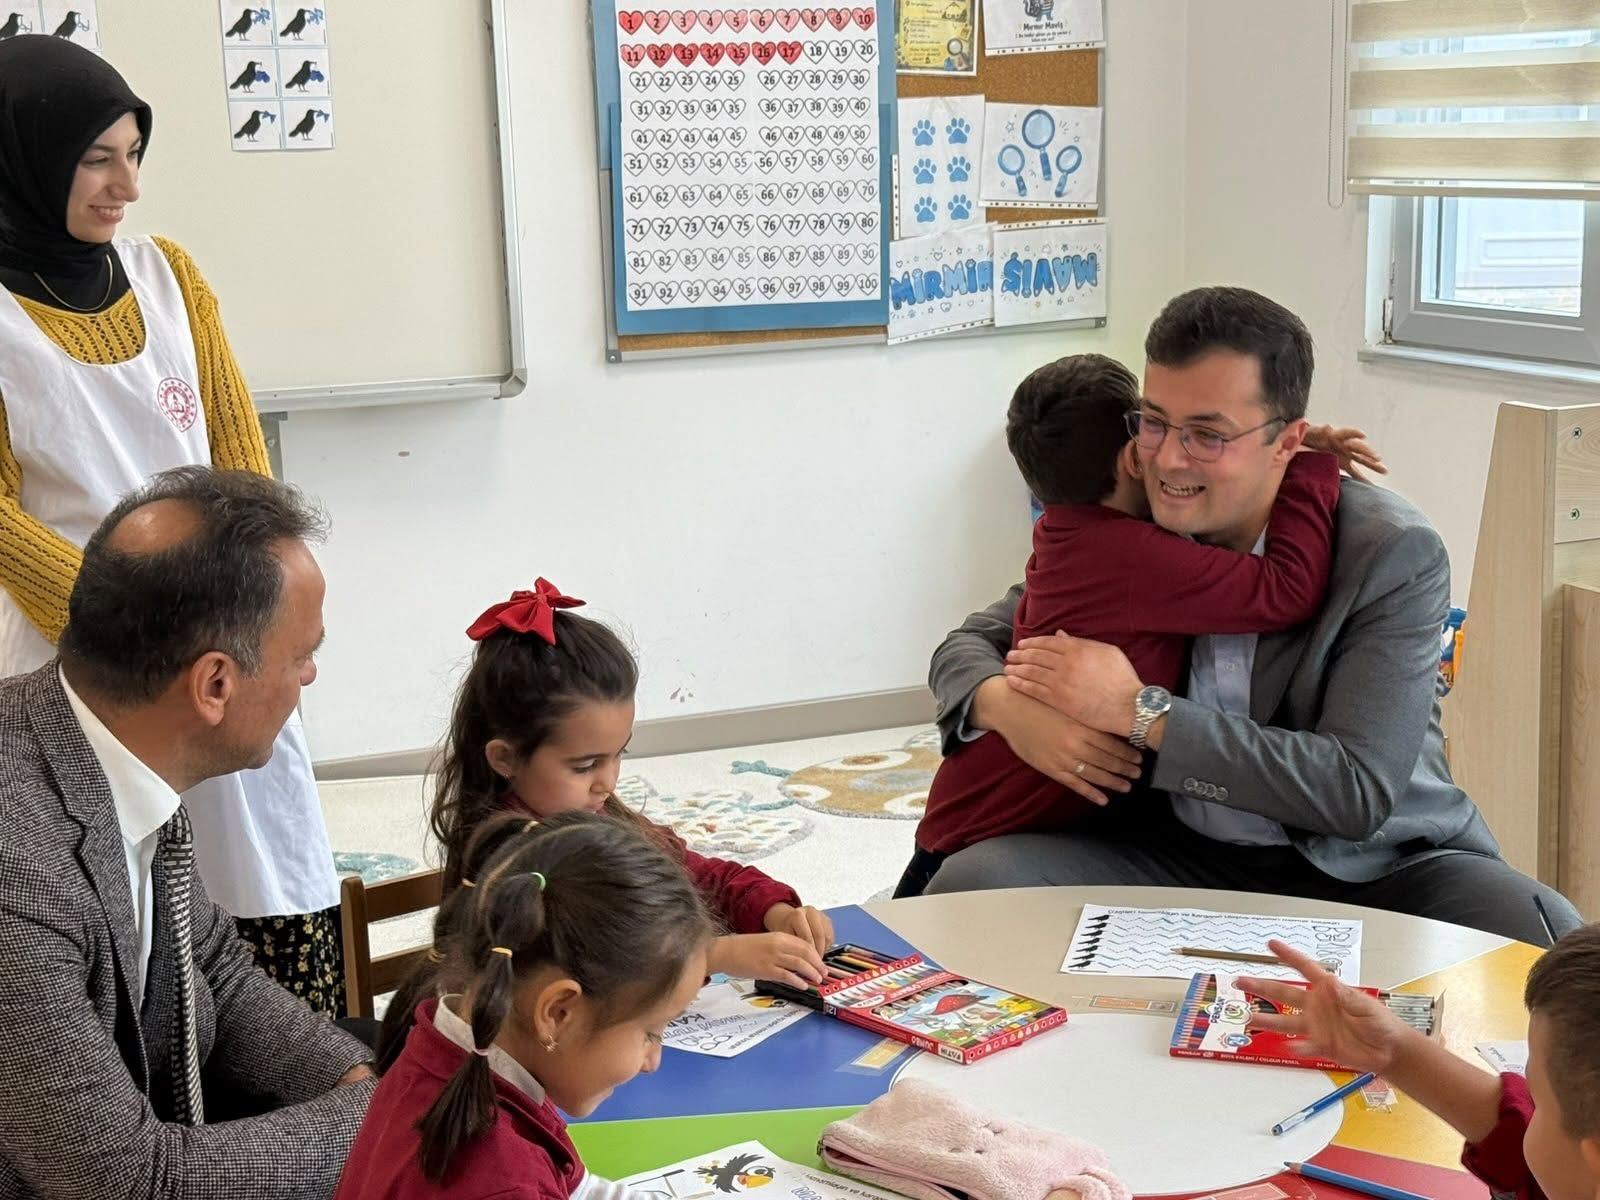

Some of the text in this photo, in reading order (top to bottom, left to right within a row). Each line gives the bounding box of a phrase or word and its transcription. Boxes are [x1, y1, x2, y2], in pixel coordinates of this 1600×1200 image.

[628, 15, 870, 29] 1 2 3 4 5 6 7 8 9 10
[628, 45, 872, 62] 11 12 13 14 15 16 17 18 19 20
[636, 74, 865, 86] 21 22 23 24 25 26 27 28 29 30
[638, 101, 865, 115] 31 32 33 34 35 36 37 38 39 40
[636, 130, 865, 144] 41 42 43 44 45 46 47 48 49 50
[630, 154, 874, 169] 51 52 53 54 55 56 57 58 59 60
[630, 186, 874, 202] 61 62 63 64 65 66 67 68 69 70
[632, 218, 873, 235] 71 72 73 74 75 76 77 78 79 80
[634, 249, 875, 267] 81 82 83 84 85 86 87 88 89 90
[634, 279, 878, 299] 91 92 93 94 95 96 97 98 99 100
